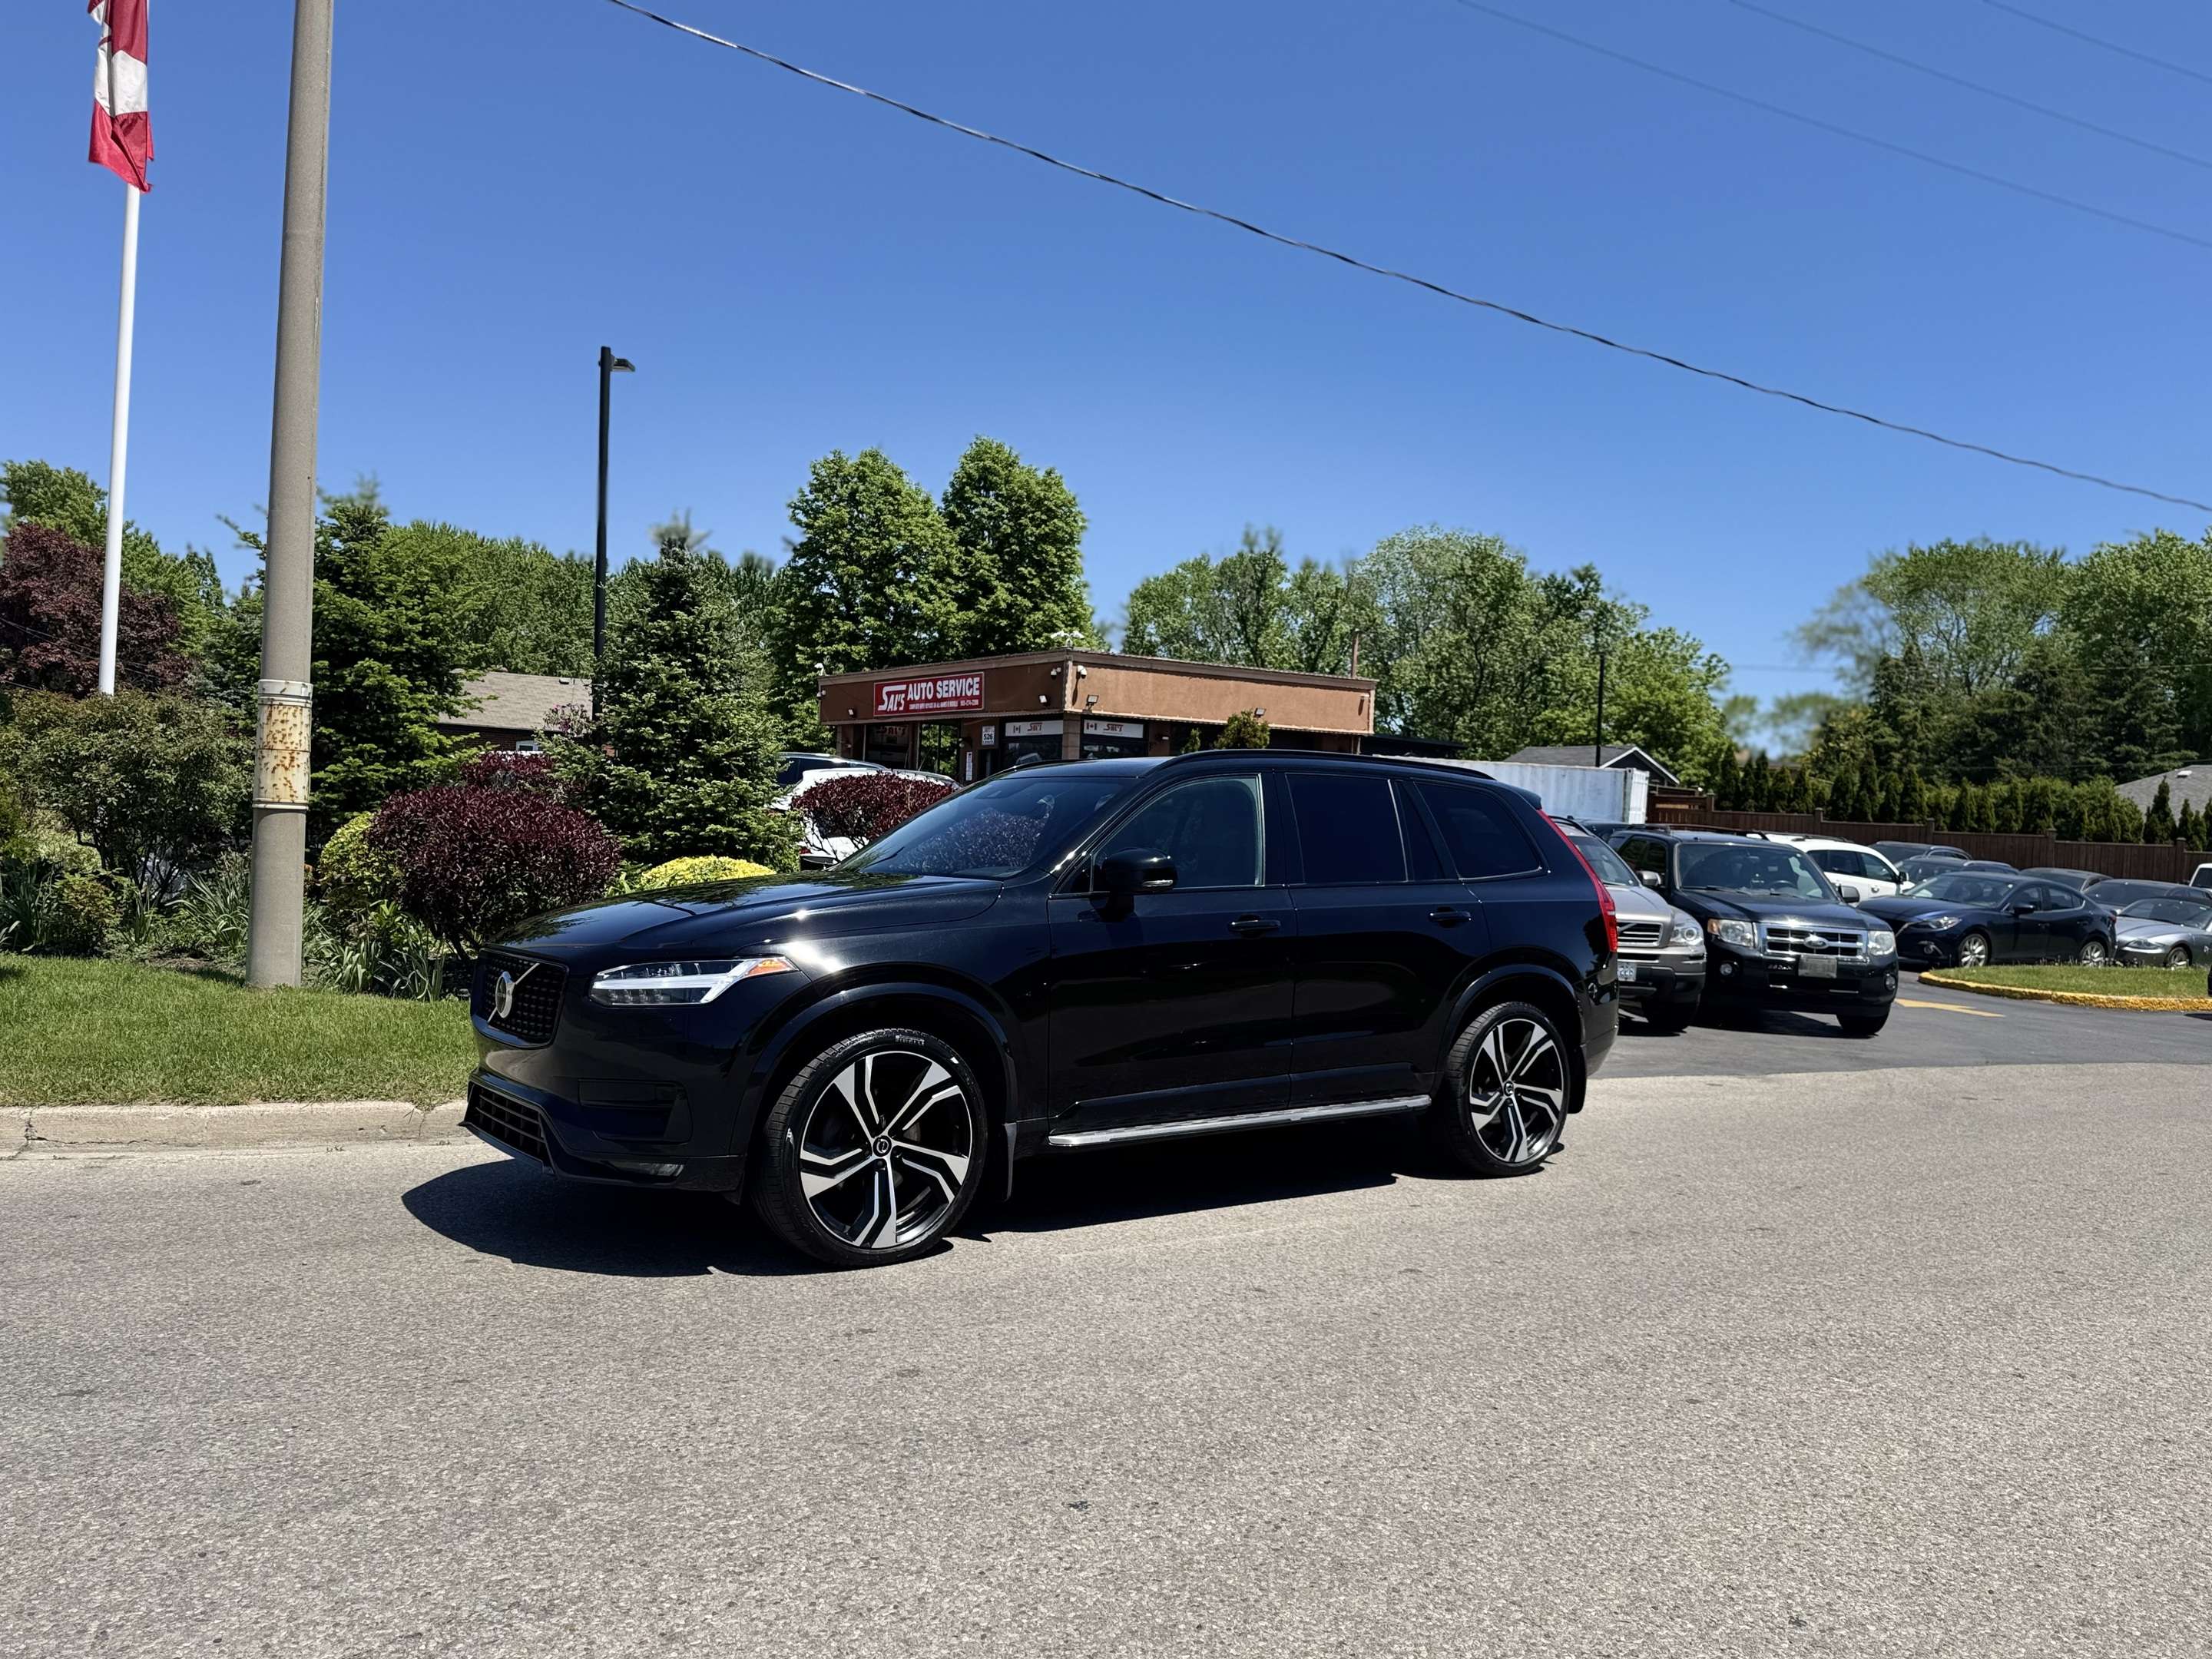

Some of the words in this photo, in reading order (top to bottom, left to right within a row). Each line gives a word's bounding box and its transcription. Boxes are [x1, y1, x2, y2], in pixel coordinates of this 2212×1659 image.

[877, 684, 906, 711] SAL'S
[907, 681, 934, 701] AUTO
[936, 677, 980, 699] SERVICE
